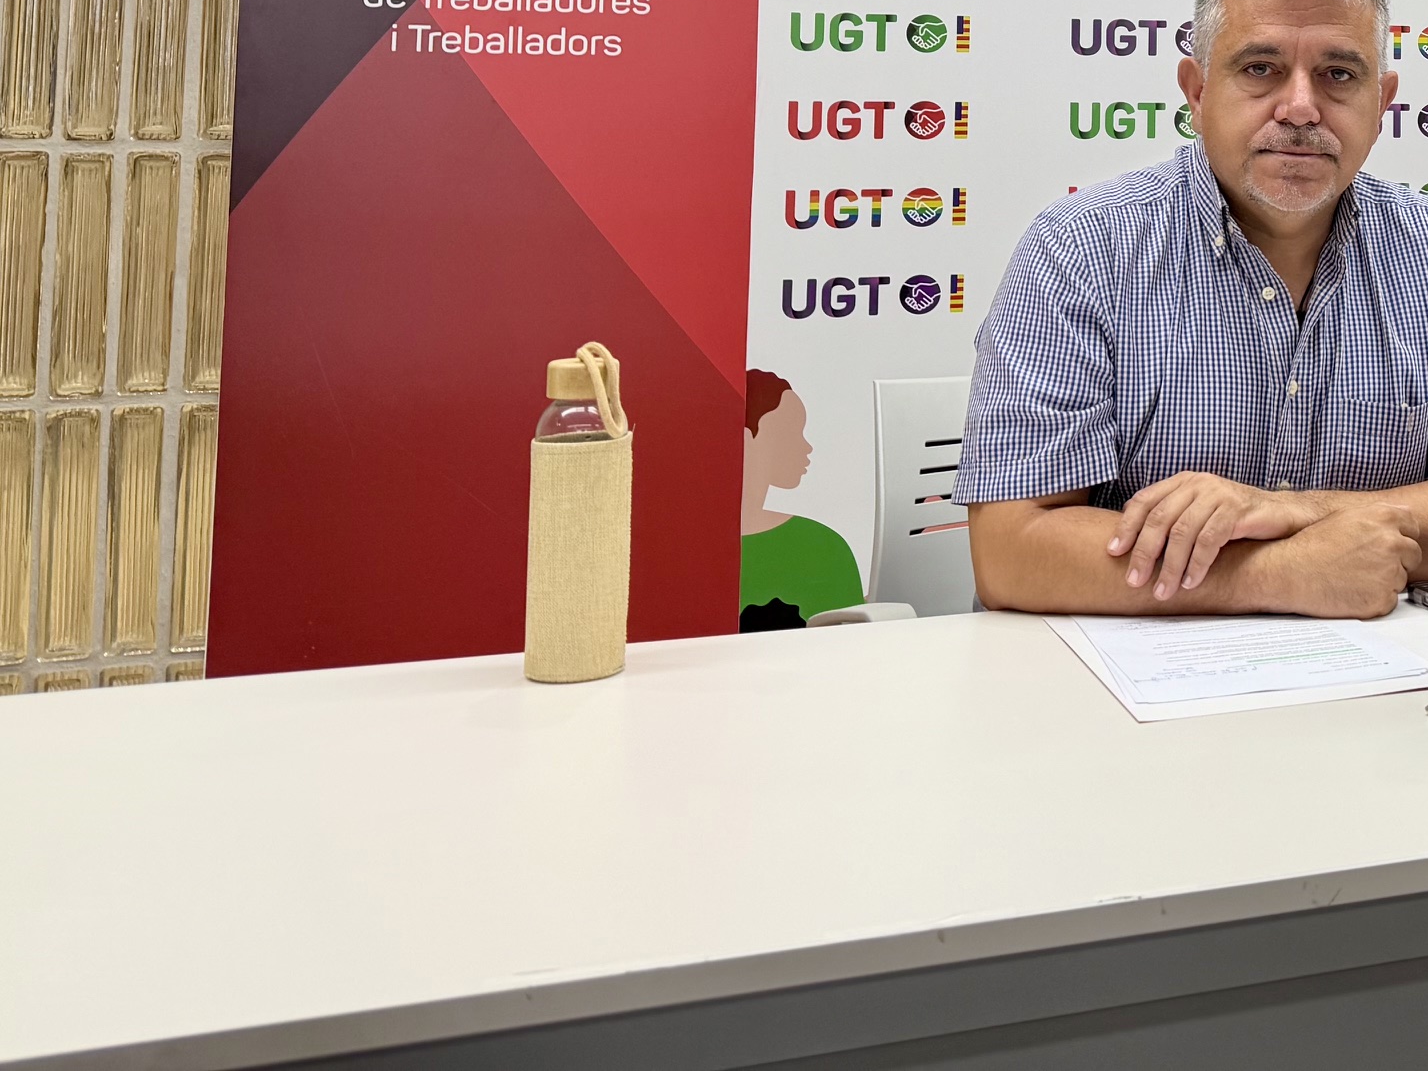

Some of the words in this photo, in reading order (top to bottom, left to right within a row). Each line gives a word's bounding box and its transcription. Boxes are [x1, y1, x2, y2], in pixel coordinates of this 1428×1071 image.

[391, 24, 398, 52] i
[408, 25, 622, 57] Treballadors
[790, 12, 897, 52] UGT
[1071, 19, 1167, 56] UGT
[788, 100, 895, 140] UGT
[1070, 102, 1166, 139] UGT
[785, 188, 893, 230] UGT
[782, 276, 890, 319] UGT
